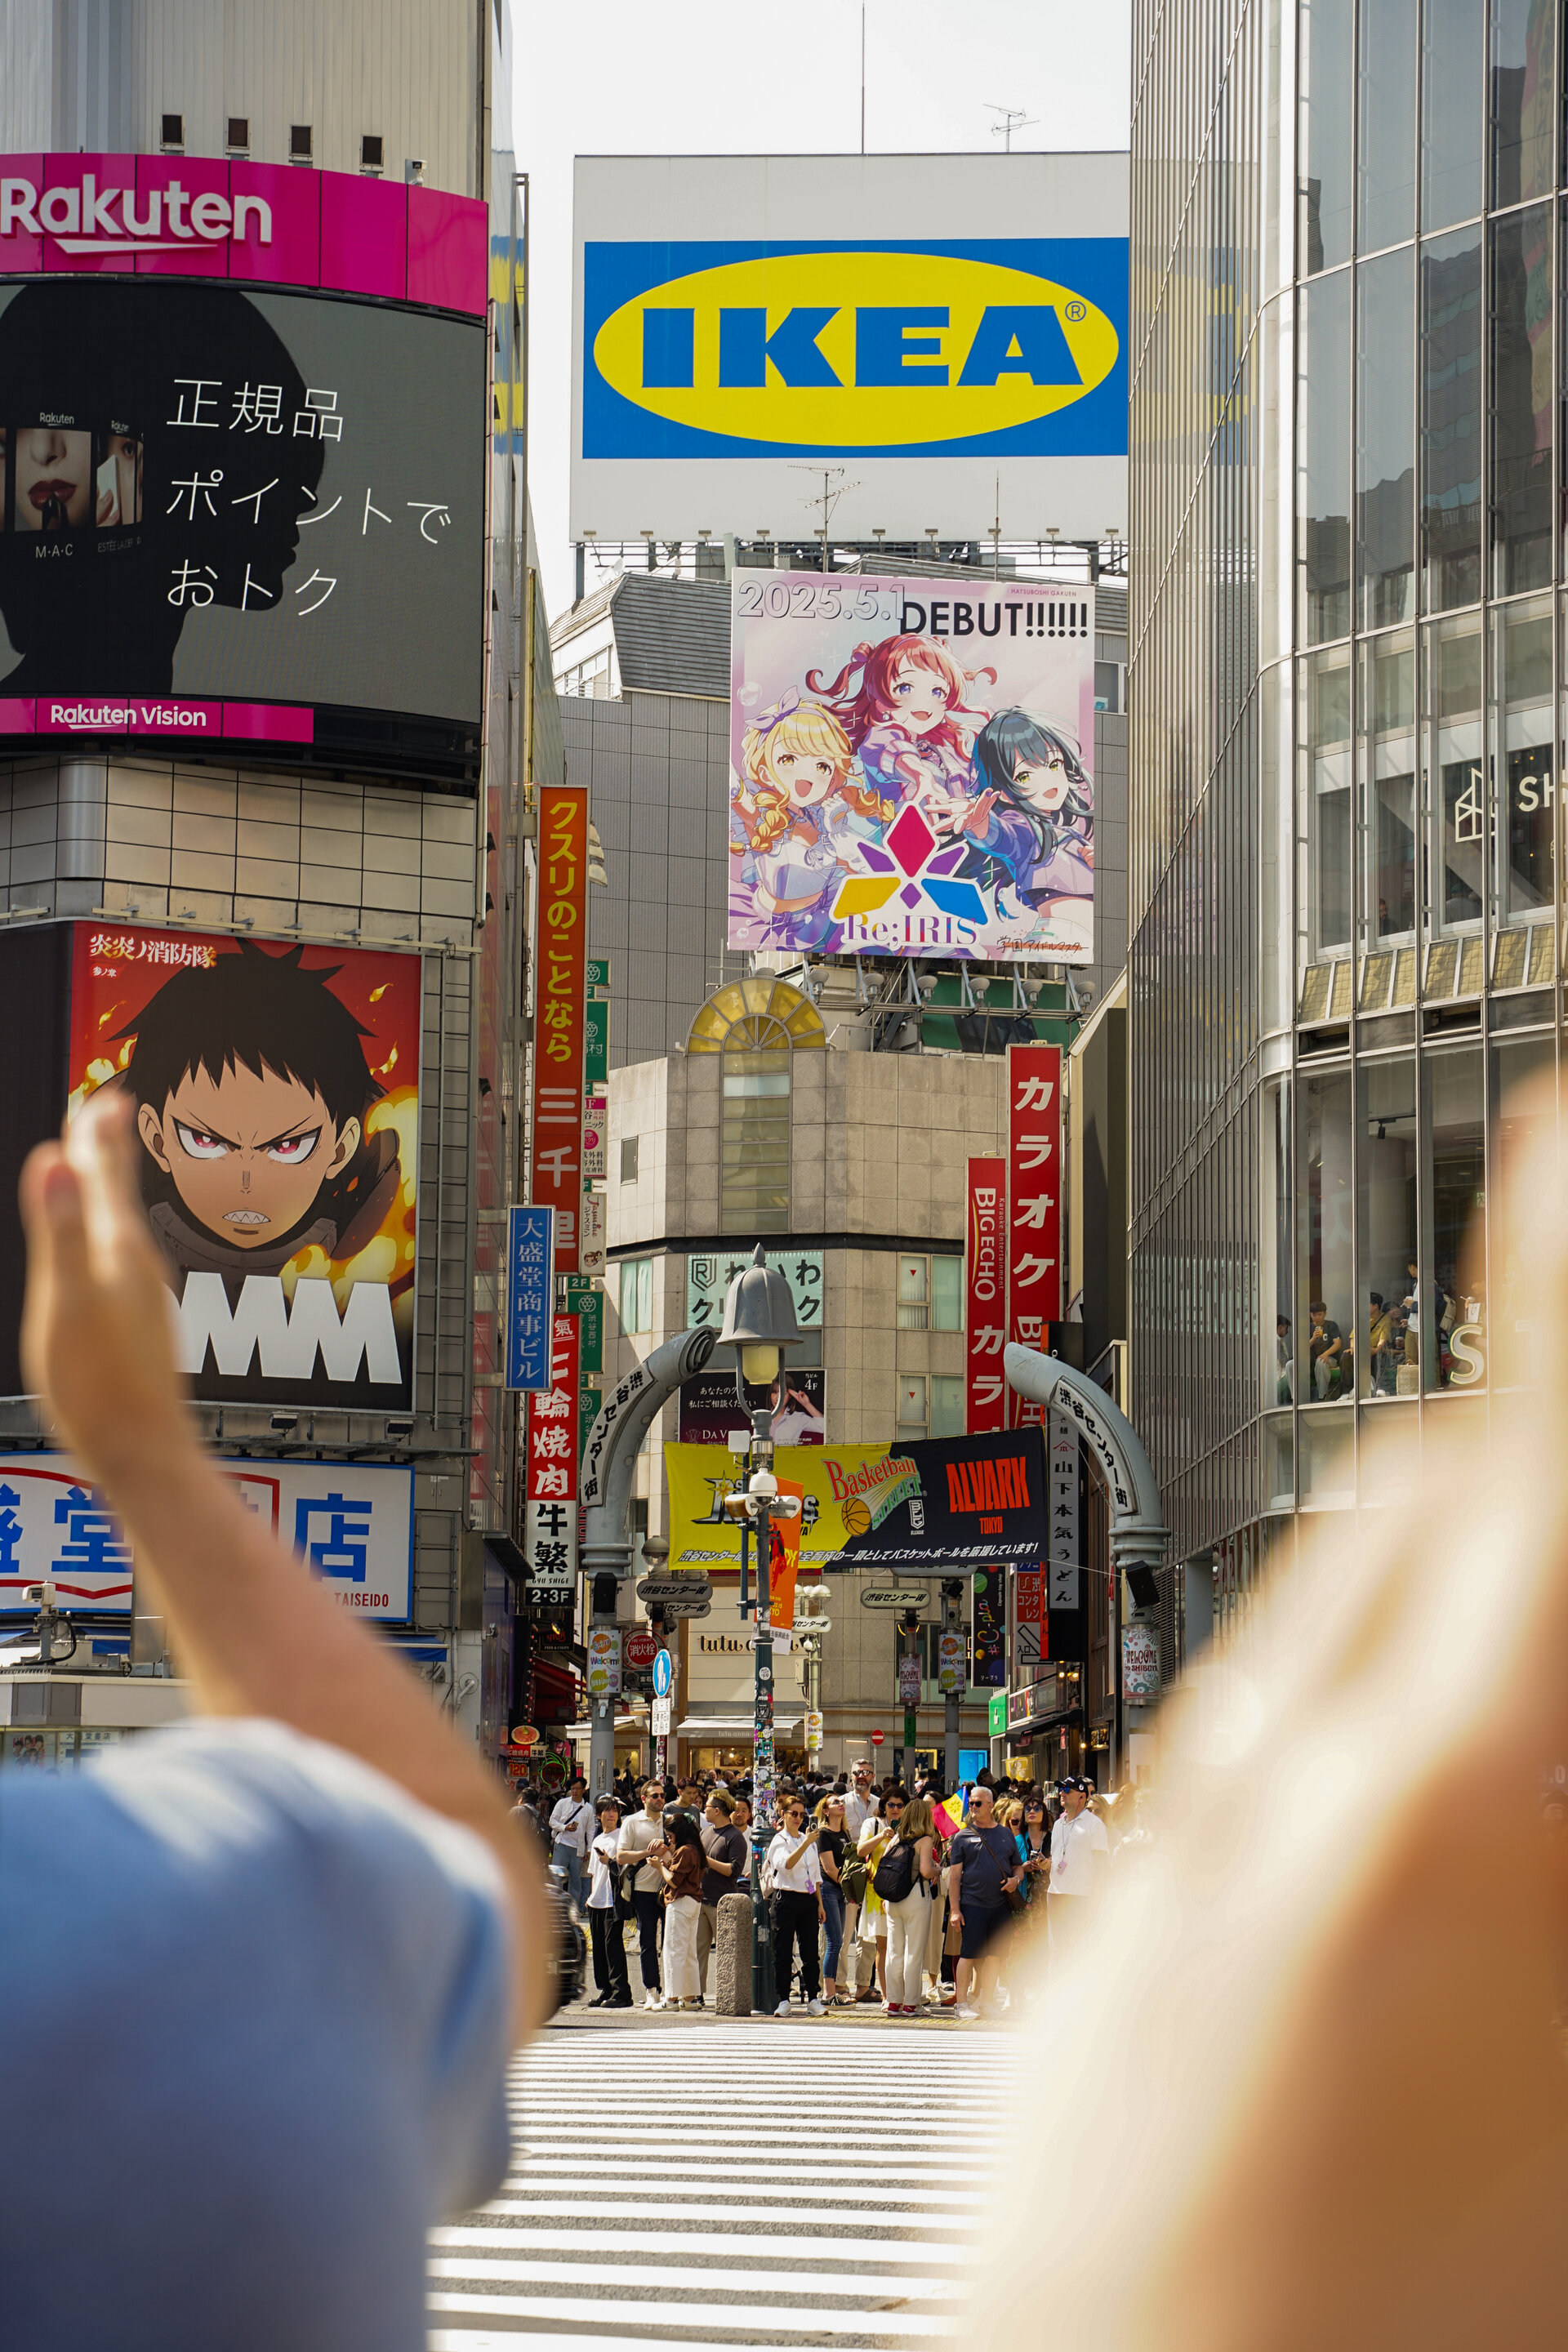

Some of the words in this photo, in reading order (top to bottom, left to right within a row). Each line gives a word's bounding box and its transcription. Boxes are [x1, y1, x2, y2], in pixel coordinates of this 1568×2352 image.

[0, 173, 272, 243] Rakuten
[641, 305, 1085, 389] IKEA
[39, 412, 74, 425] Rakuten
[166, 378, 344, 443] 正規品
[166, 469, 452, 545] ポイントで
[167, 558, 338, 616] おトク
[737, 580, 906, 621] 2025.5.1
[1011, 588, 1049, 596] HATSUBOSHI
[899, 601, 1089, 639] DEBUT!!!!!!
[51, 704, 136, 724] Rakuten
[141, 706, 207, 727] Vision
[543, 800, 579, 1063] クスリのことなら
[996, 934, 1089, 954] 学園アイドルマスター
[90, 933, 217, 969] 炎炎ノ消防隊
[1013, 1076, 1055, 1288] カラオケ
[974, 1187, 996, 1232] BIG
[572, 1278, 588, 1288] 2F
[974, 1236, 996, 1301] ECHO
[516, 1217, 545, 1380] 大盛堂商事ビル
[586, 1313, 598, 1348] 渋谷西村
[804, 1378, 818, 1391] 4F
[584, 1370, 644, 1502] 渋谷センター街
[1059, 1387, 1129, 1508] 渋谷センター街
[825, 1455, 919, 1503] Basketball
[946, 1456, 1031, 1513] ALVARK
[871, 1475, 924, 1531] STREET
[534, 1502, 569, 1575] 牛繁
[978, 1516, 1004, 1535] TOKYO
[1054, 1460, 1074, 1602] 山下本気うどん
[640, 1585, 709, 1596] 渋谷センター街
[664, 1604, 707, 1612] センター街
[864, 1592, 928, 1603] 渋谷センター街
[792, 1619, 829, 1628] 谷センター街
[590, 1655, 620, 1665] Welcome
[593, 1638, 610, 1651] Enjoy
[630, 1643, 655, 1657] 消火栓
[697, 1635, 743, 1652] tutu
[1017, 1645, 1031, 1654] 入口
[1125, 1649, 1157, 1664] WELCOME
[1131, 1664, 1158, 1673] SHIBUYA
[66, 1732, 112, 1740] 大堂書店
